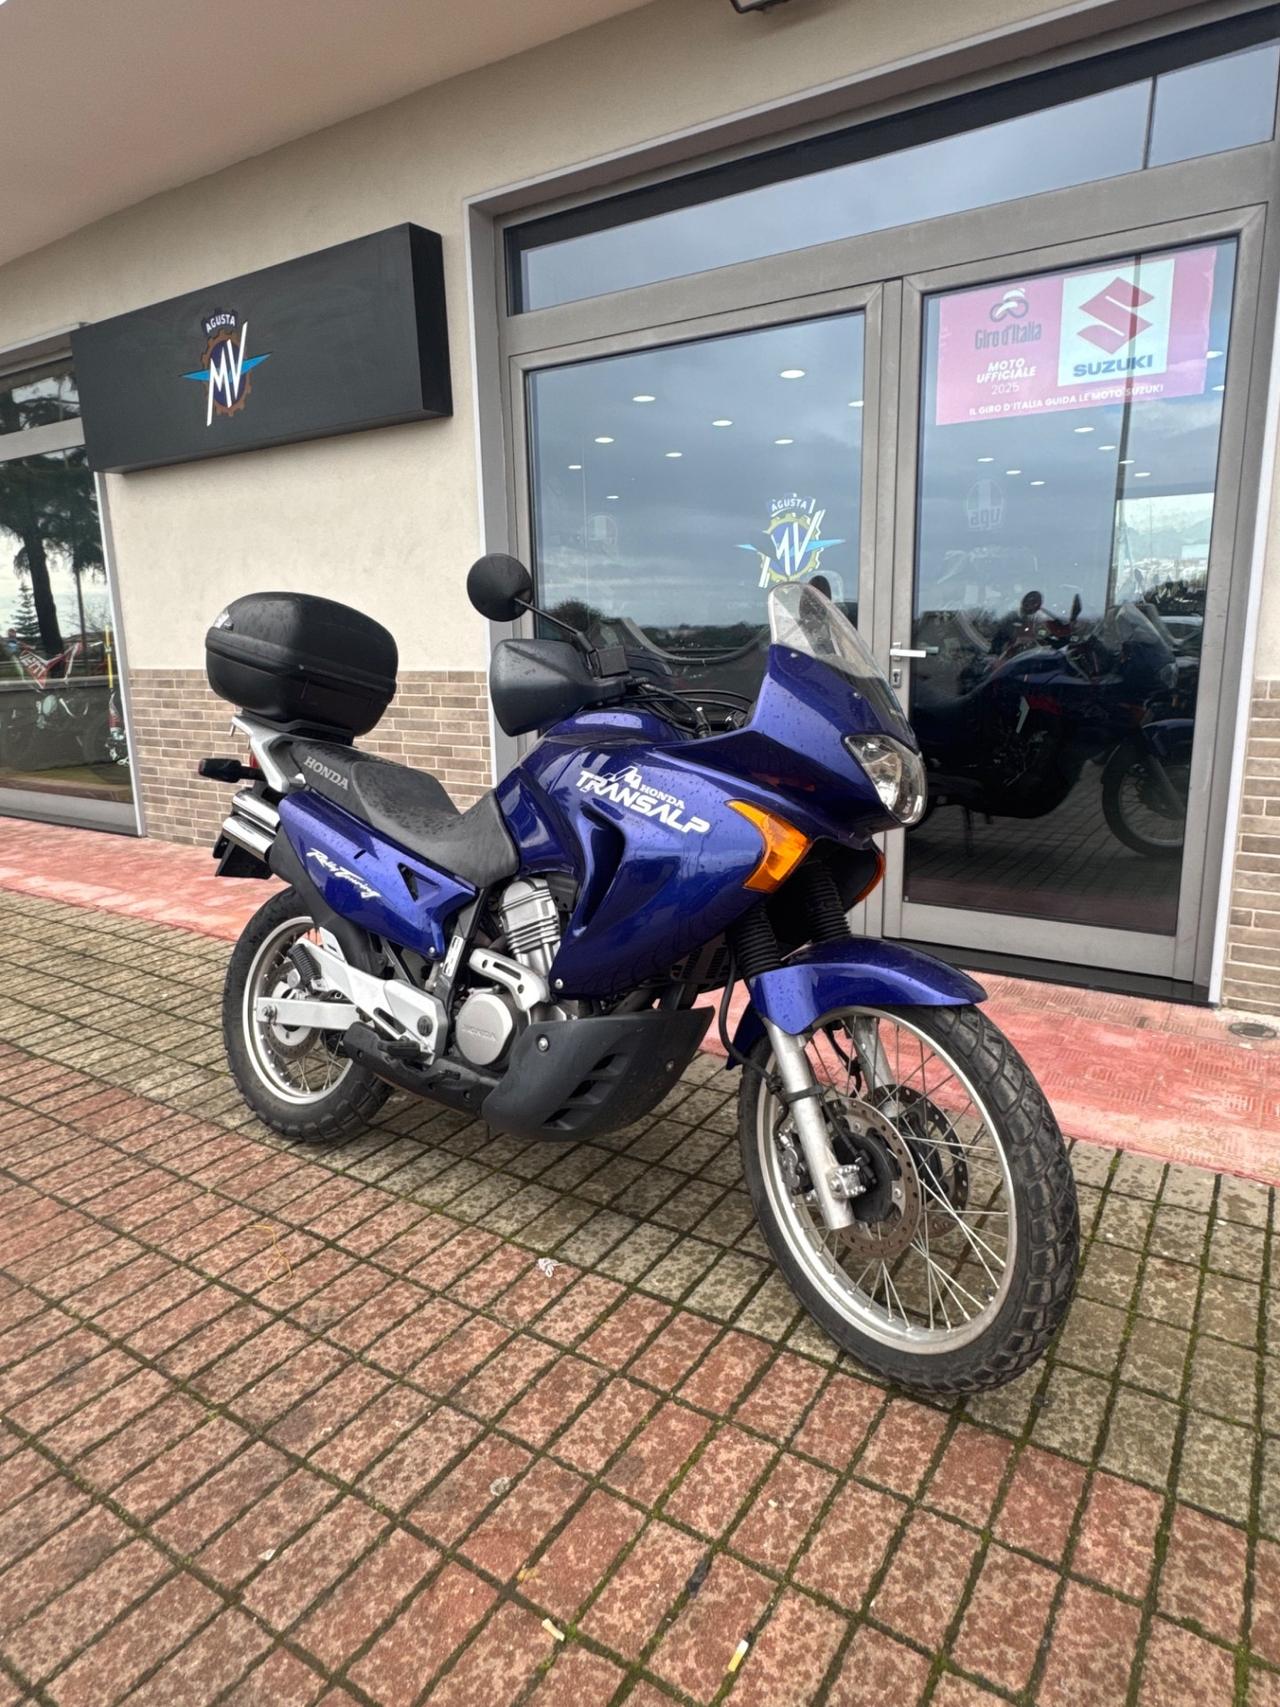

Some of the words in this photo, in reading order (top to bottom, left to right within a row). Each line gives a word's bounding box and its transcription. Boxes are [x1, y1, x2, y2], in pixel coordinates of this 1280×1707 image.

[206, 314, 236, 333] AGUSTA
[975, 329, 1000, 350] Giro
[1001, 320, 1042, 346] d'Italia
[206, 321, 248, 427] MV
[976, 366, 1037, 384] UFFICIALE
[987, 358, 1025, 372] MOTO
[1073, 354, 1153, 377] SUZUKI
[969, 408, 977, 416] IL
[978, 404, 1002, 415] GIRO
[1003, 399, 1043, 411] D'ITALIA
[1044, 394, 1077, 406] GUIDA
[1079, 392, 1090, 402] LE
[1091, 388, 1123, 401] MOTO
[1124, 384, 1164, 397] SUZUKI
[992, 382, 1020, 395] 2025
[771, 498, 807, 513] AGUSTA
[304, 756, 349, 791] HONDA
[576, 770, 711, 833] TRANSALP
[639, 784, 686, 810] HONDA
